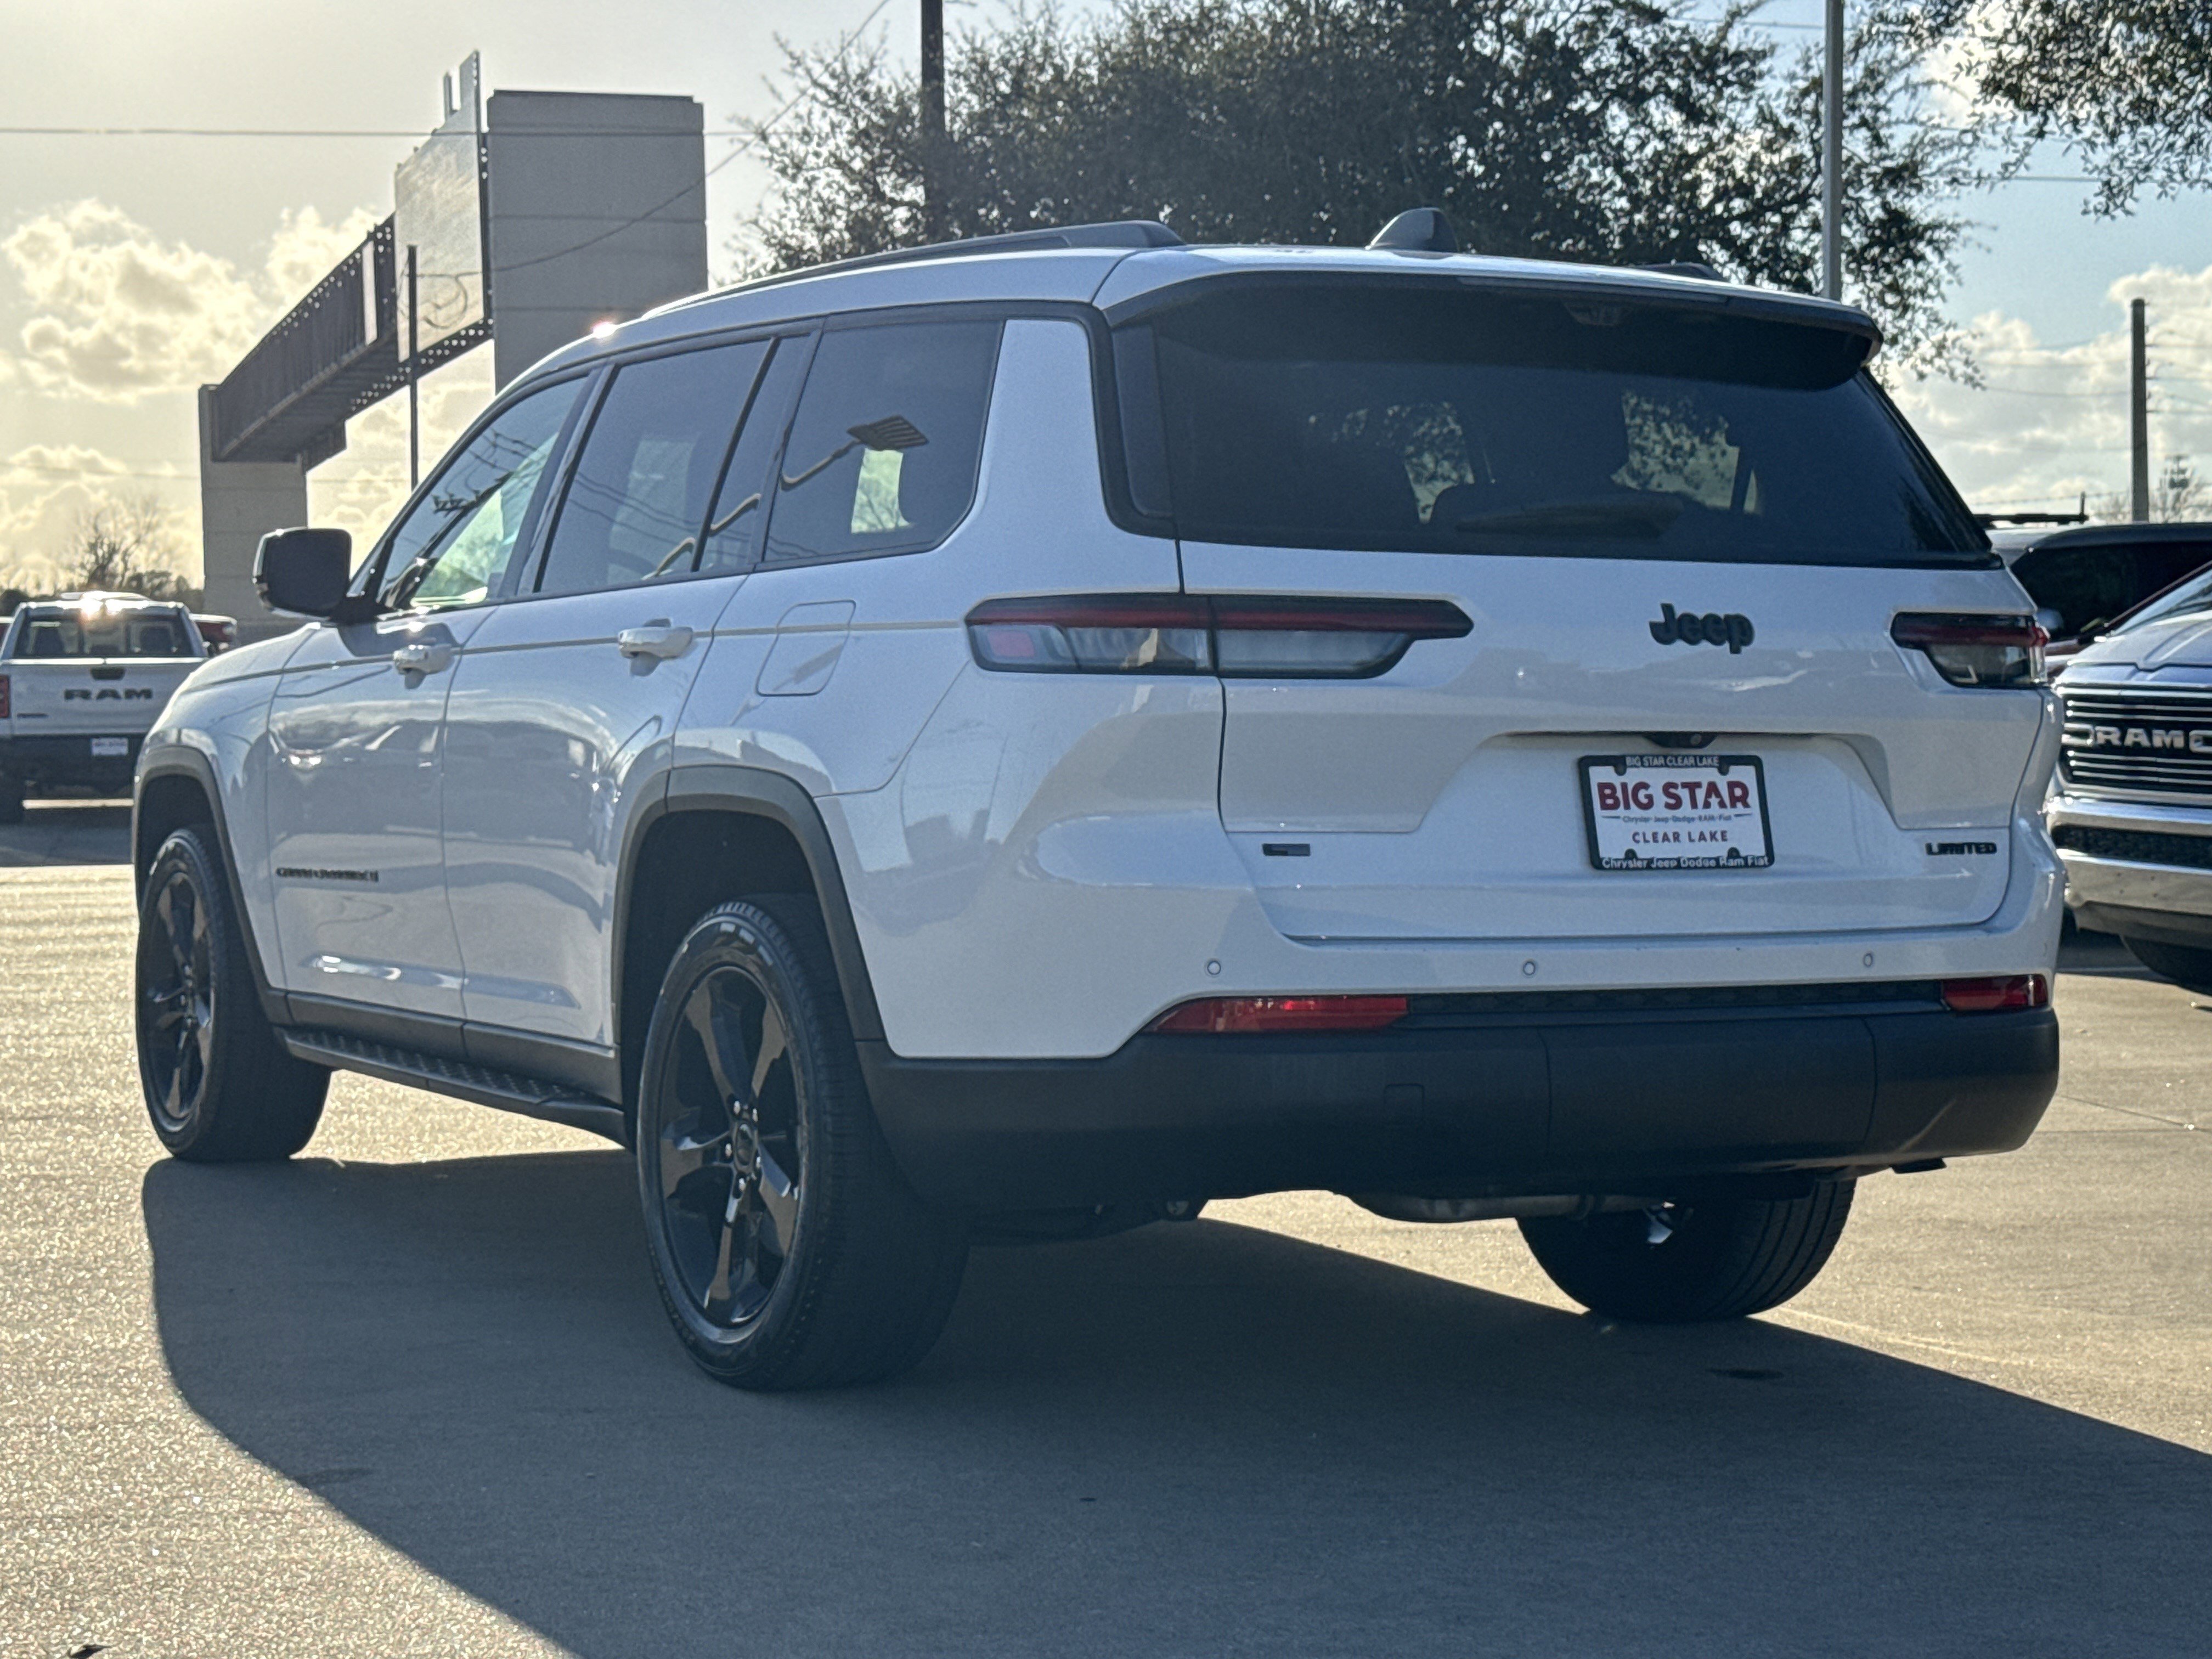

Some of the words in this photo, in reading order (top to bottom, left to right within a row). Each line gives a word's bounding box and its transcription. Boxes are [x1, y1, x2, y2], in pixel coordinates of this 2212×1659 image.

[1649, 603, 1754, 654] Jeep
[64, 689, 153, 699] RAM
[2094, 726, 2184, 748] RAM
[1626, 757, 1641, 766] BIG
[1643, 757, 1665, 766] STAR
[1666, 756, 1695, 766] CLEAR
[1696, 756, 1719, 766] LAKE
[1597, 782, 1654, 811] BIG
[1662, 780, 1751, 810] STAR
[1632, 831, 1681, 843] CLEAR
[1688, 830, 1728, 843] LAKE
[1602, 857, 1647, 868] Chrysler
[1650, 857, 1677, 868] Jeep
[1680, 856, 1717, 867] Dodge
[1719, 856, 1745, 866] Ram
[1747, 855, 1769, 866] Fiat
